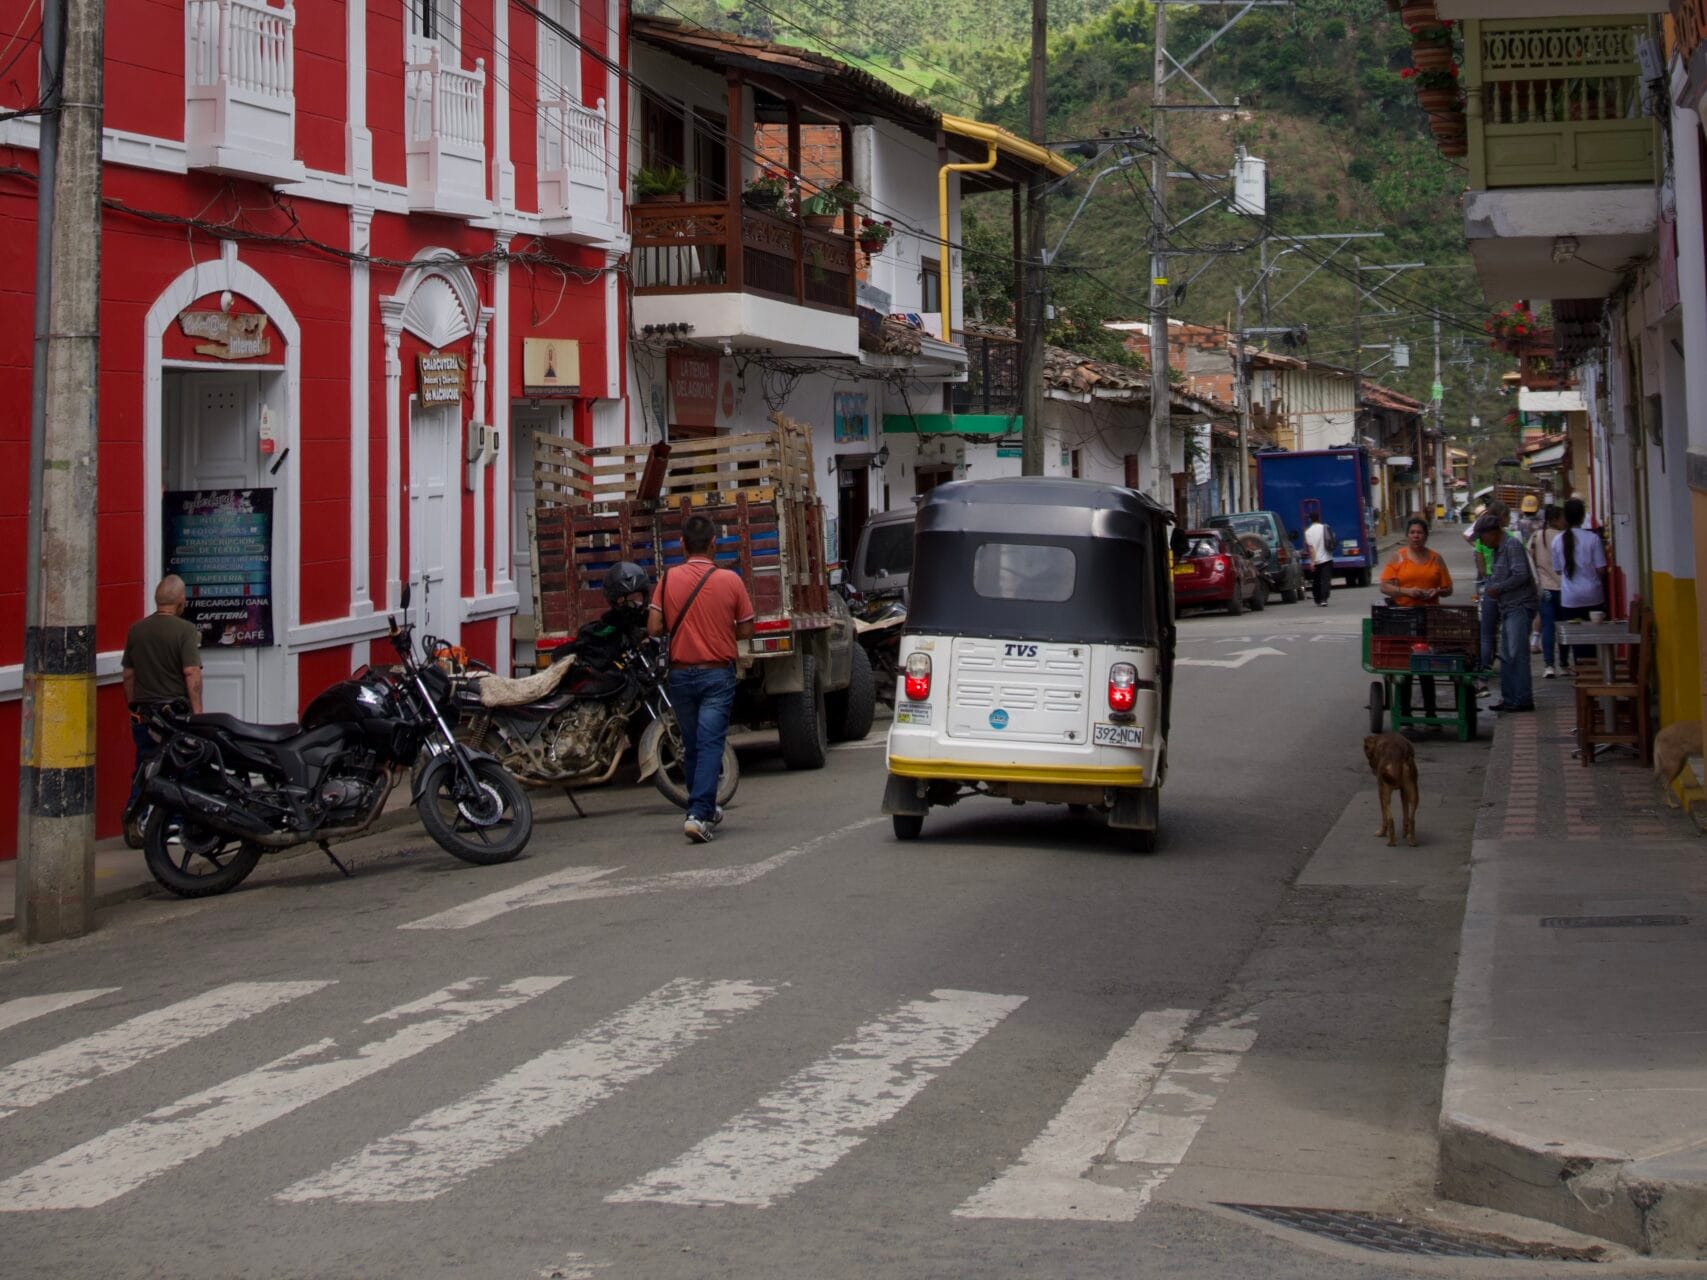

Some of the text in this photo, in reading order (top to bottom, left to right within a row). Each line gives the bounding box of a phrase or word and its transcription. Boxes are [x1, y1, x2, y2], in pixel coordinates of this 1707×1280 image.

[229, 336, 260, 353] Internet
[214, 546, 240, 554] TEXTO
[170, 556, 220, 565] CERTIFICADO
[232, 554, 269, 563] LIBERTAD
[200, 585, 241, 595] NETFLIX
[195, 599, 241, 608] RECARGAS
[245, 598, 269, 606] GANA
[236, 629, 265, 640] CAFÉ
[1005, 644, 1038, 657] TVS
